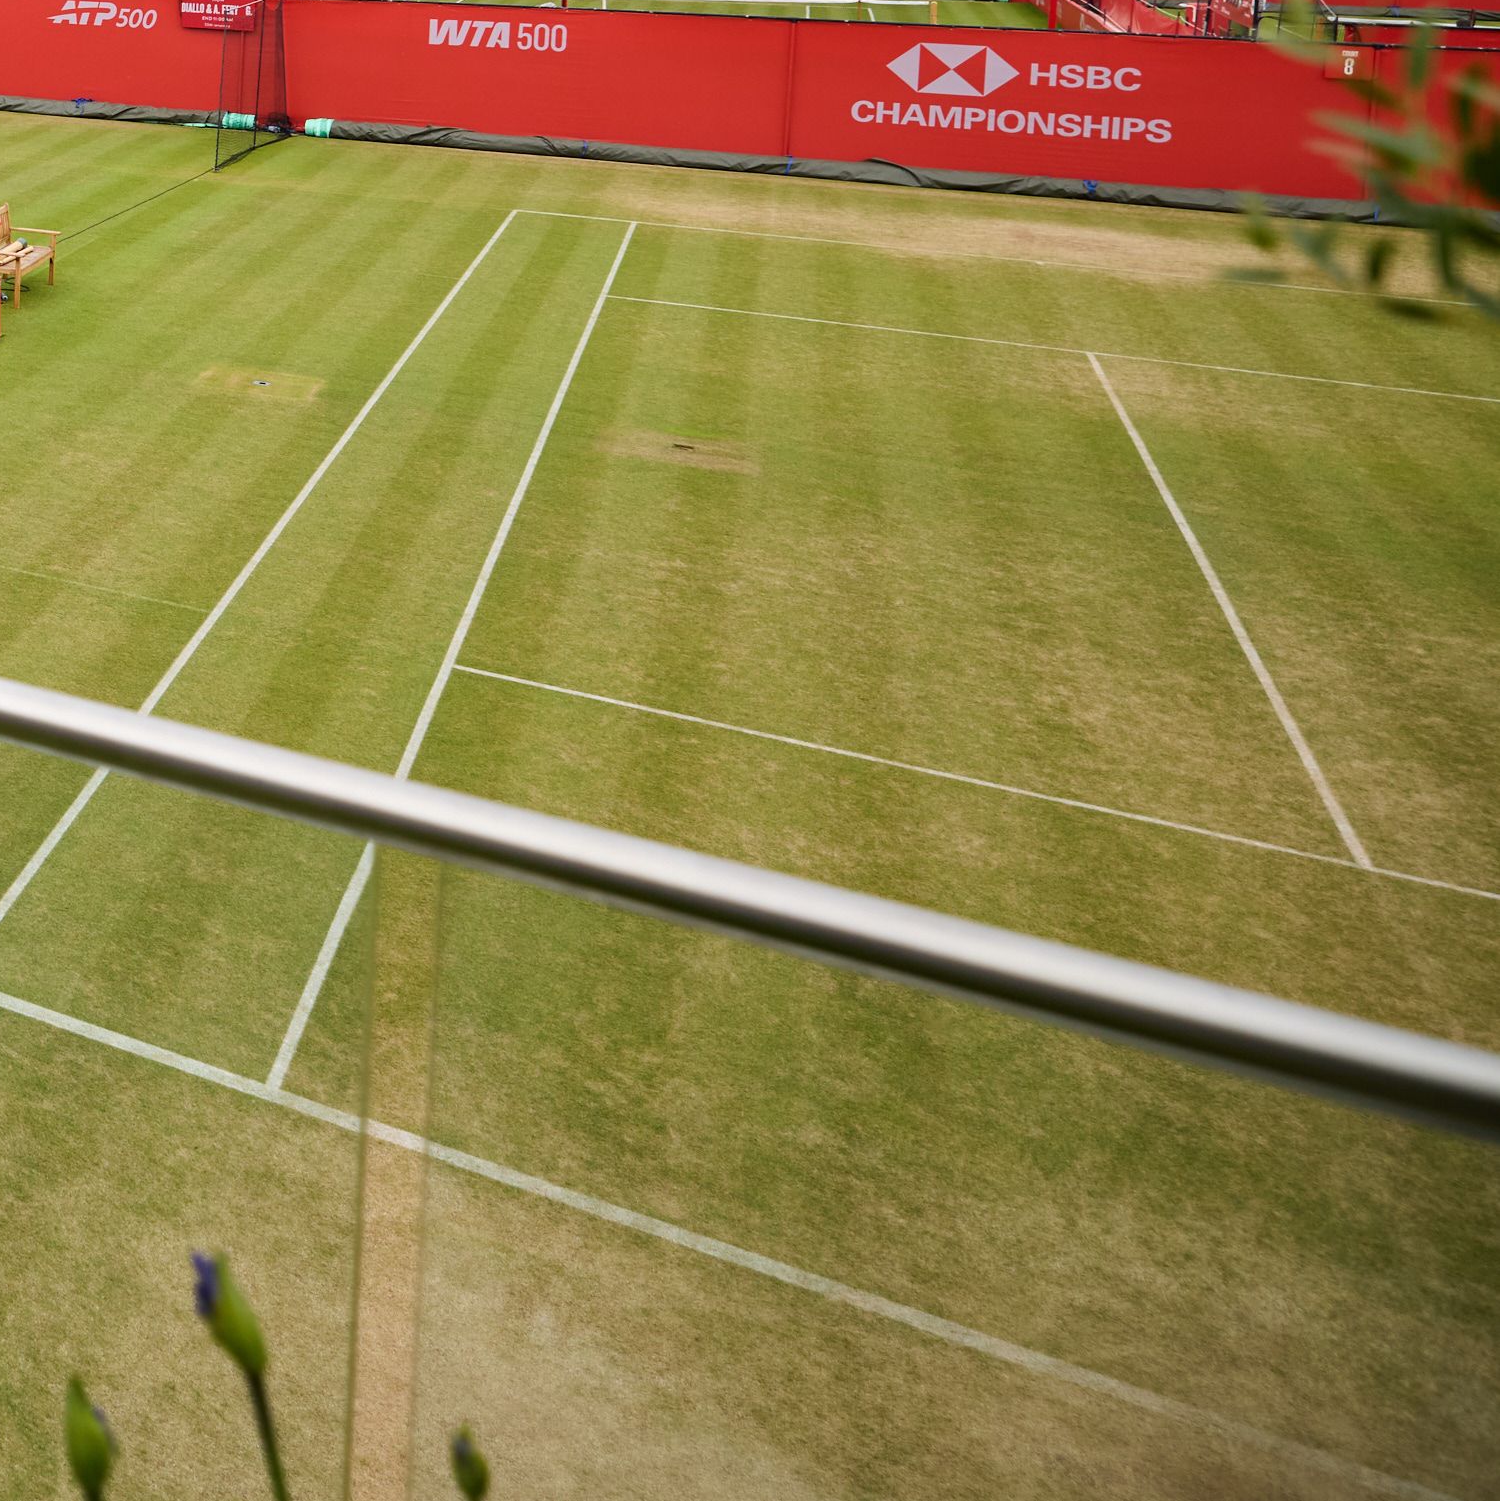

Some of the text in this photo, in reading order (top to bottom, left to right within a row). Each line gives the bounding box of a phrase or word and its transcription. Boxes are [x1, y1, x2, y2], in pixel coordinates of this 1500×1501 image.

[48, 0, 158, 30] ATP 500
[181, 2, 205, 14] DIALLO
[206, 3, 212, 14] &
[213, 4, 220, 15] A.
[428, 18, 568, 52] WTA 500
[1029, 62, 1142, 92] HSBC
[1343, 57, 1355, 75] 8
[850, 99, 1173, 144] CHAMPIONSHIPS
